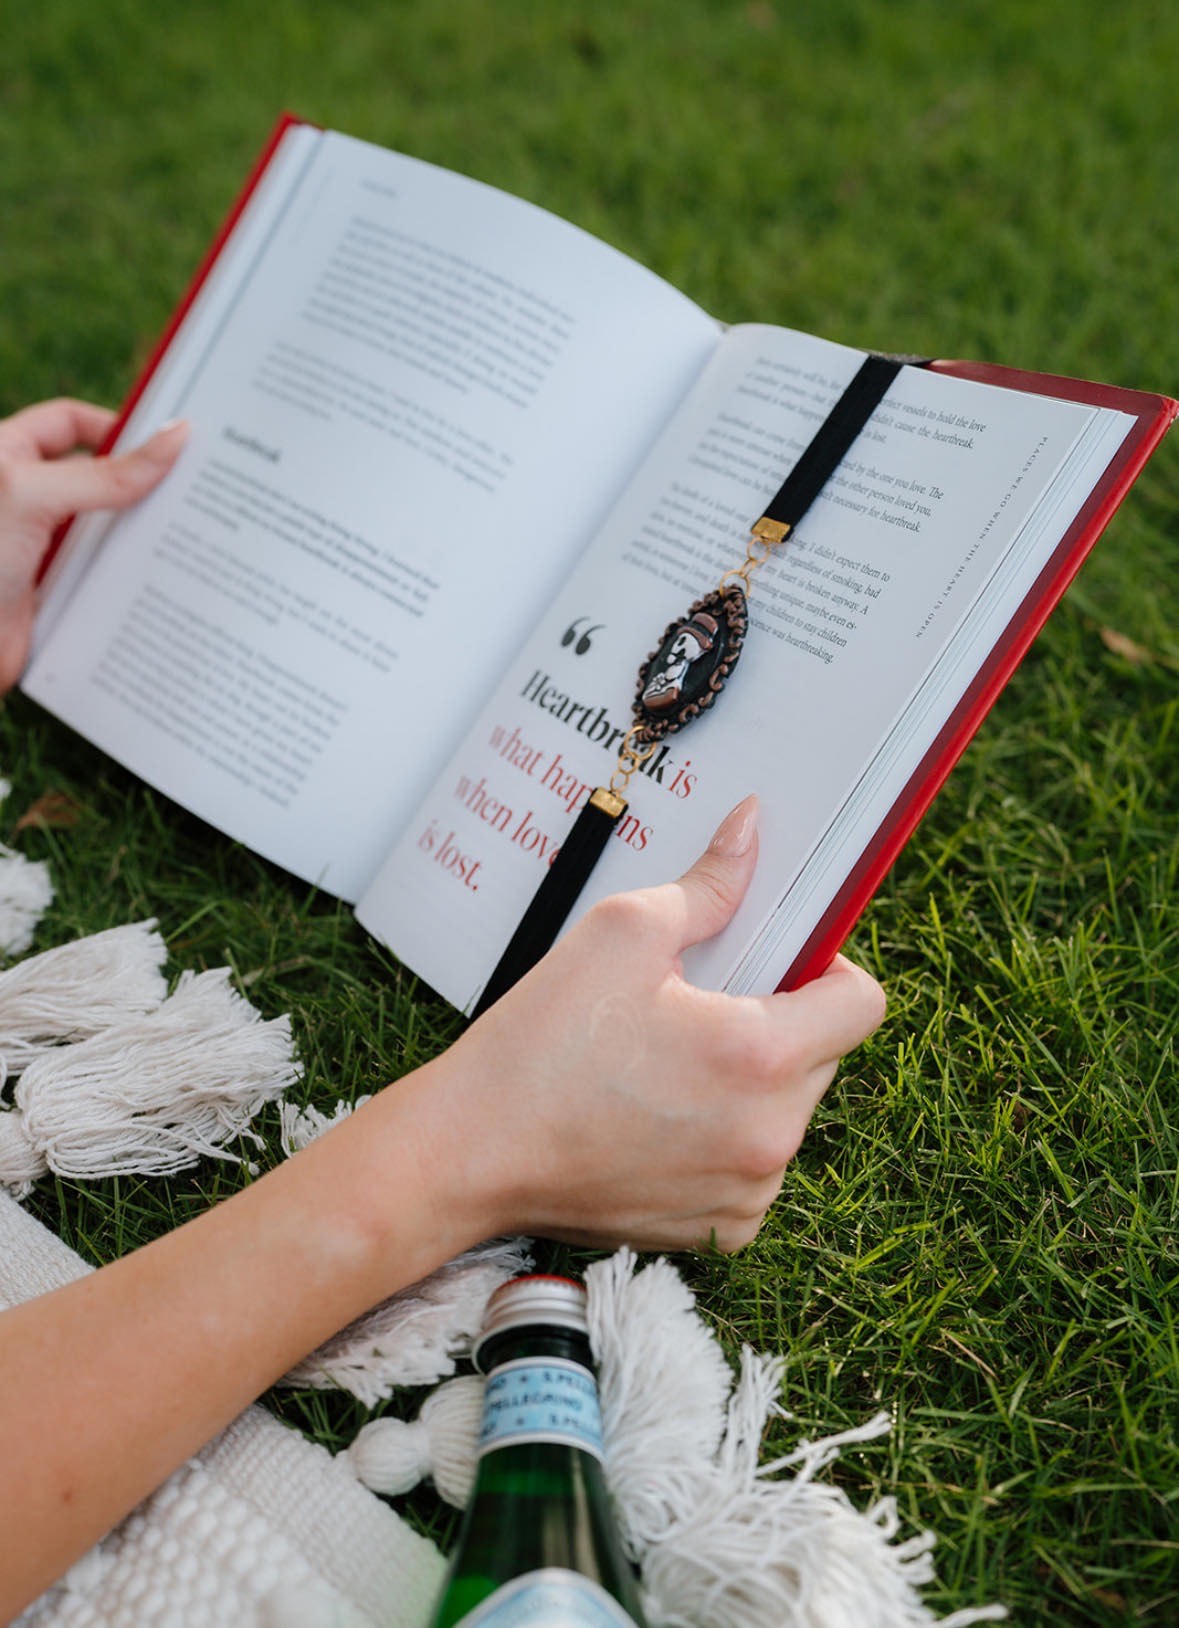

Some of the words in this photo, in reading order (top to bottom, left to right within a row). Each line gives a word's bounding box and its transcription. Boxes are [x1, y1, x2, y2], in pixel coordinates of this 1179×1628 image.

[917, 425, 931, 437] the
[932, 430, 975, 449] heartbreak.
[936, 411, 957, 424] hold
[954, 416, 969, 428] the
[968, 419, 986, 432] love
[836, 477, 849, 487] the
[848, 482, 869, 495] other
[866, 489, 894, 504] person
[894, 496, 918, 510] loved
[914, 505, 931, 517] you,
[865, 467, 879, 479] the
[879, 474, 894, 484] one
[892, 479, 909, 489] you
[929, 486, 944, 499] The
[1012, 476, 1023, 489] WE
[833, 496, 868, 515] necessary
[867, 506, 881, 518] for
[880, 511, 922, 532] heartbreak.
[1000, 493, 1011, 507] GO
[979, 512, 1000, 539] WHEN
[814, 545, 836, 560] didn't
[835, 556, 861, 570] expect
[860, 564, 880, 578] them
[881, 572, 890, 582] to
[965, 544, 980, 561] THE
[777, 569, 797, 584] heart
[805, 580, 831, 599] broken
[831, 595, 859, 612] anyway.
[860, 605, 869, 615] A
[822, 570, 834, 579] of
[831, 574, 863, 594] smoking,
[864, 584, 881, 598] bad
[943, 566, 965, 597] HEART
[805, 604, 829, 618] maybe
[828, 614, 846, 626] even
[846, 622, 856, 630] es-
[933, 600, 943, 609] IS
[766, 605, 795, 623] children
[794, 617, 804, 627] to
[802, 623, 818, 636] stay
[817, 628, 847, 647] children
[916, 613, 934, 637] OPEN
[772, 629, 786, 639] was
[785, 633, 833, 664] heartbreaking.
[488, 724, 543, 776] what
[540, 754, 654, 851] hapns
[668, 760, 698, 799] is
[453, 774, 513, 832] when
[416, 817, 438, 853] is
[433, 831, 483, 892] lost.
